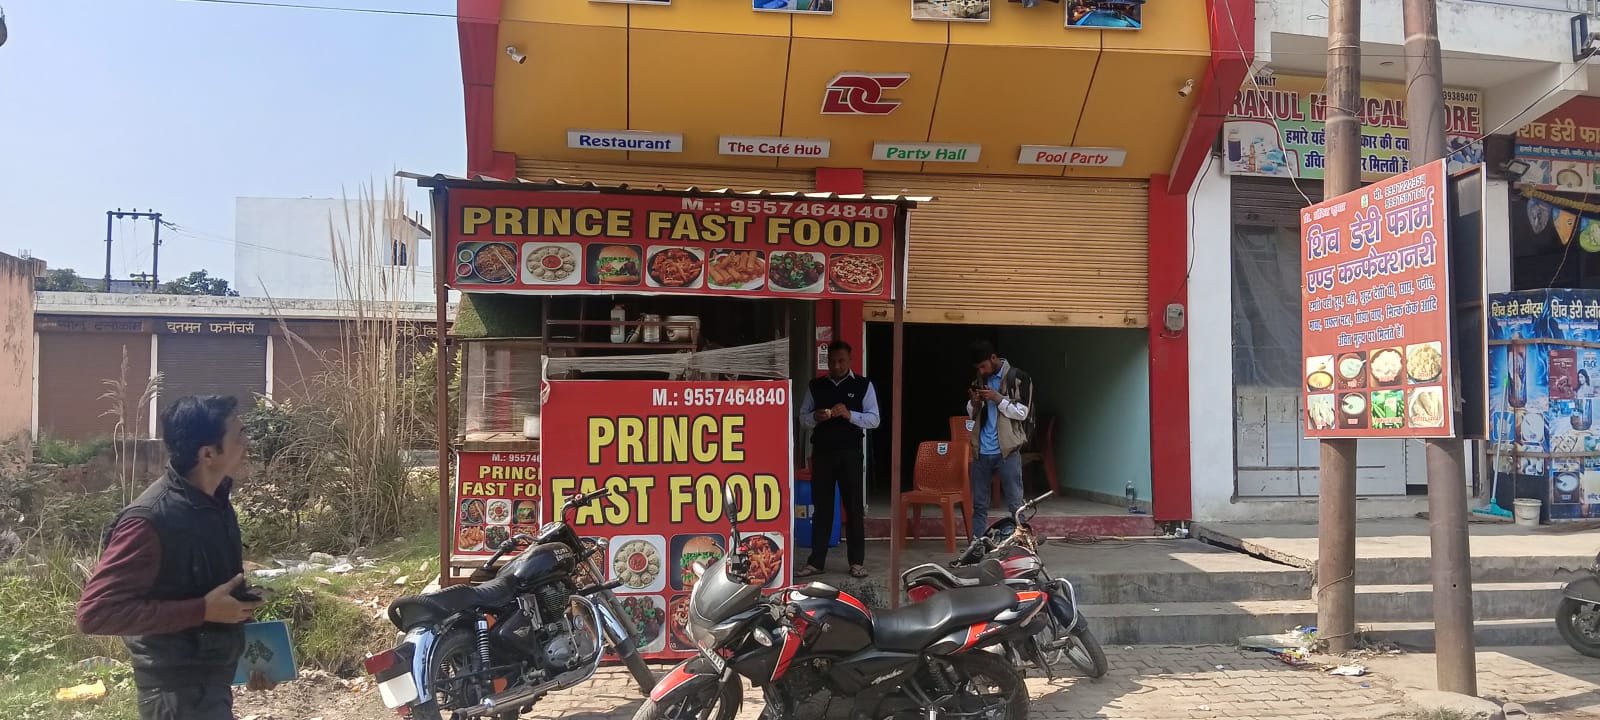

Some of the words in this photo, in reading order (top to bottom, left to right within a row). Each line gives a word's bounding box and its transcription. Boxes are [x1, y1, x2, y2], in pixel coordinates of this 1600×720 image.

[1285, 126, 1310, 145] हमारे
[1379, 132, 1393, 150] की
[1550, 118, 1577, 142] डेरी
[579, 134, 672, 150] Restaurant
[728, 142, 754, 153] The
[758, 143, 790, 154] Café
[794, 145, 822, 156] Hub
[886, 147, 931, 161] Party
[935, 149, 967, 161] Hall
[1035, 151, 1067, 163] Pool
[1069, 152, 1108, 165] Party
[1369, 155, 1400, 173] मिलती
[681, 197, 721, 212] M.:
[729, 199, 890, 220] 9557464840
[462, 206, 634, 238] PRINCE
[648, 213, 754, 244] FAST
[768, 217, 882, 250] FOOD
[1307, 224, 1341, 261] शिव
[1350, 205, 1382, 250] डेरी
[1386, 186, 1435, 237] फार्म
[1306, 266, 1335, 293] एण्ड
[1491, 302, 1505, 317] शिव
[1507, 300, 1519, 316] डेरी
[1551, 300, 1567, 318] शिव
[1569, 299, 1583, 319] डेरी
[167, 321, 203, 334] चुनमुन
[653, 388, 679, 405] M.:
[683, 386, 786, 406] 9557464840
[587, 414, 745, 465] PRINCE
[479, 465, 541, 480] PRINC
[462, 481, 508, 496] FAST
[551, 474, 655, 525] FAST
[669, 473, 782, 522] FOOD
